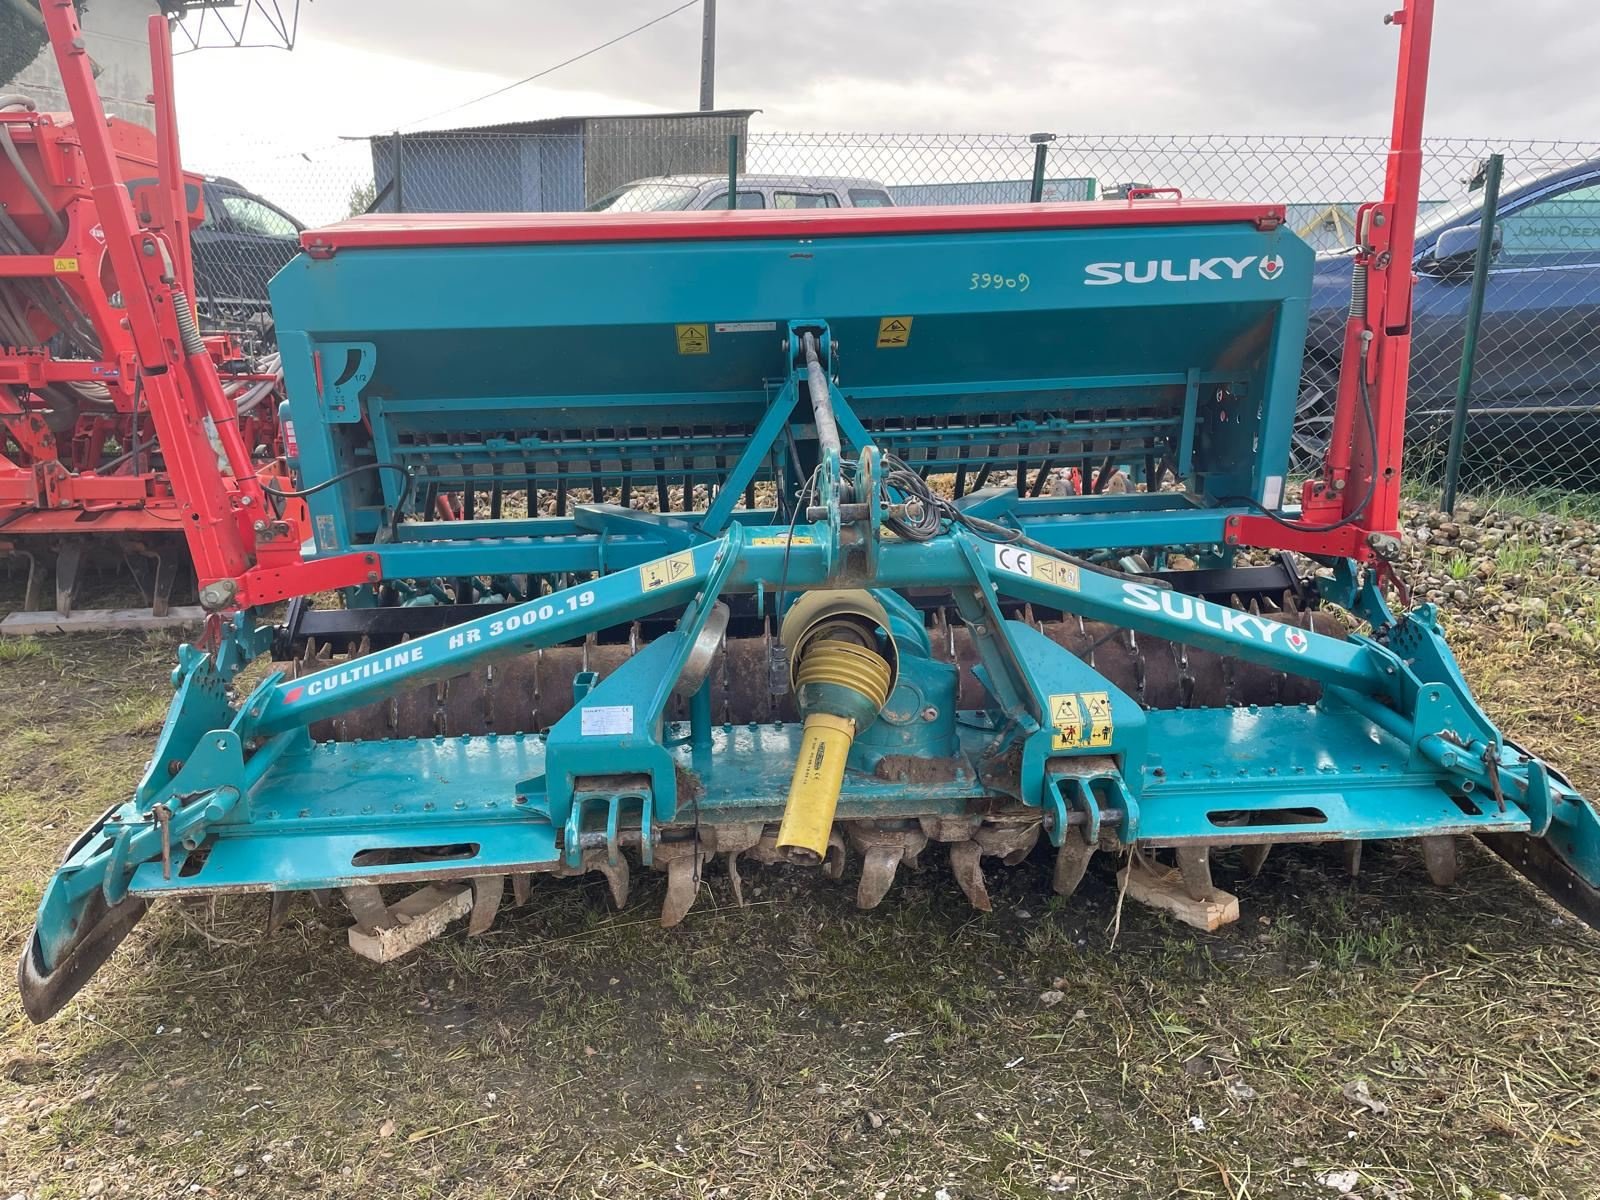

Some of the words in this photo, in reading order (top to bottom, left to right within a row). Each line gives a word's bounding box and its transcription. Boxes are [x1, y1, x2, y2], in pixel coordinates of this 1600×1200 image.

[969, 273, 1030, 292] 39909
[1084, 255, 1258, 286] SULKY
[999, 547, 1029, 575] CE
[1122, 582, 1278, 643] SULKY
[307, 646, 424, 696] CULTILINE
[448, 628, 481, 651] HR
[489, 590, 596, 637] 3000.19
